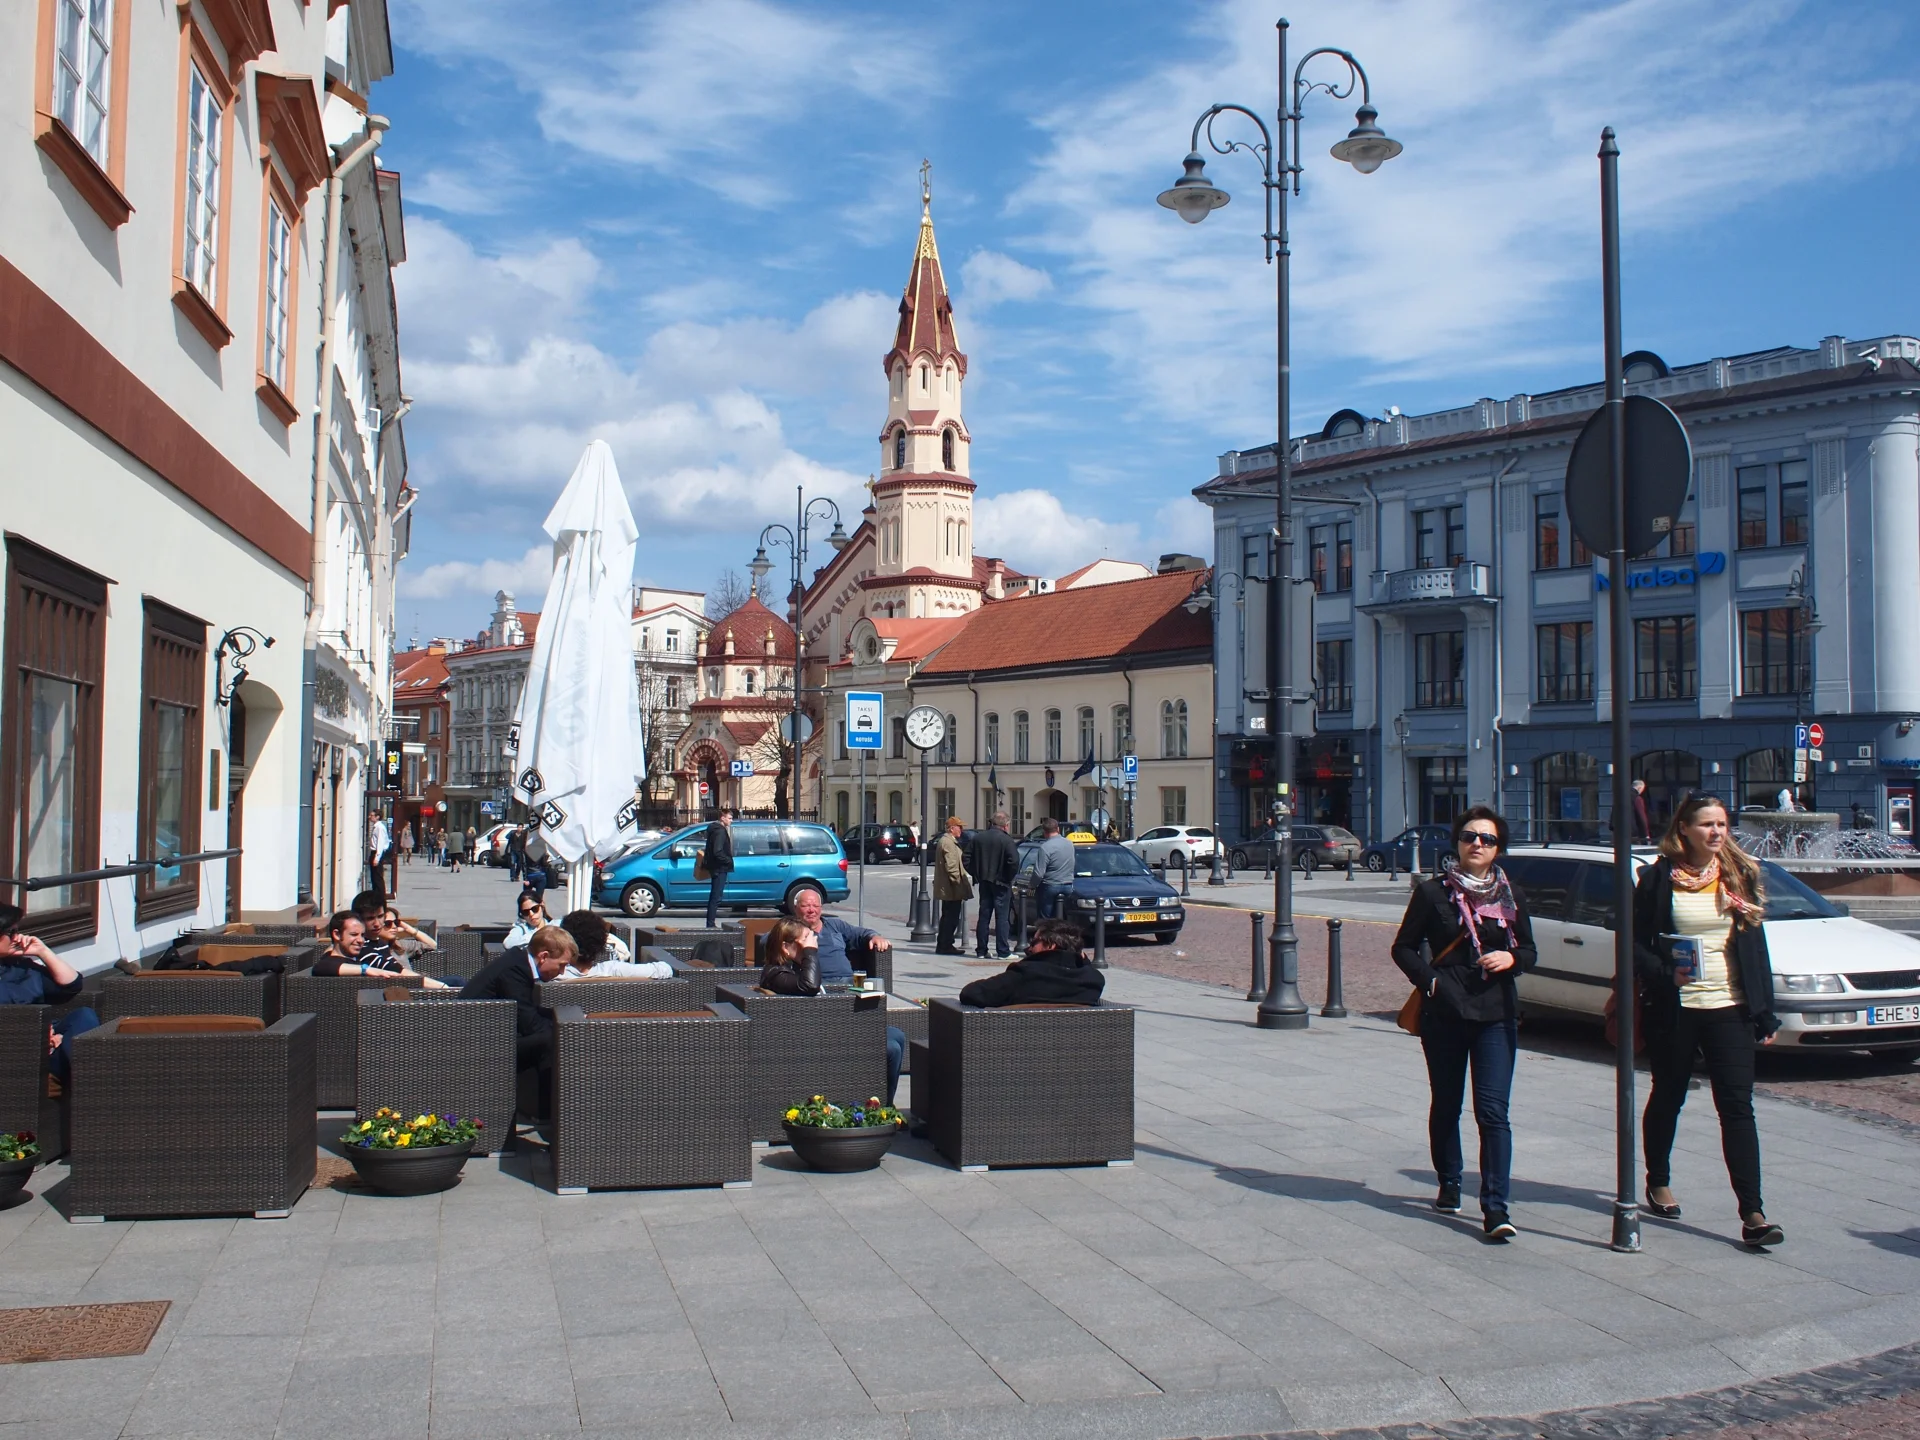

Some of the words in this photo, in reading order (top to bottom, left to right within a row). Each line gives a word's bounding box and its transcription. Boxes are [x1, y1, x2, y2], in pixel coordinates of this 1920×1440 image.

[1596, 565, 1696, 592] Nrdea
[1798, 728, 1806, 746] P
[1860, 747, 1868, 757] 18
[386, 750, 400, 775] spot
[731, 761, 742, 776] P
[1126, 757, 1136, 772] P
[1875, 1007, 1904, 1022] EHE
[1912, 1006, 1919, 1020] 9
